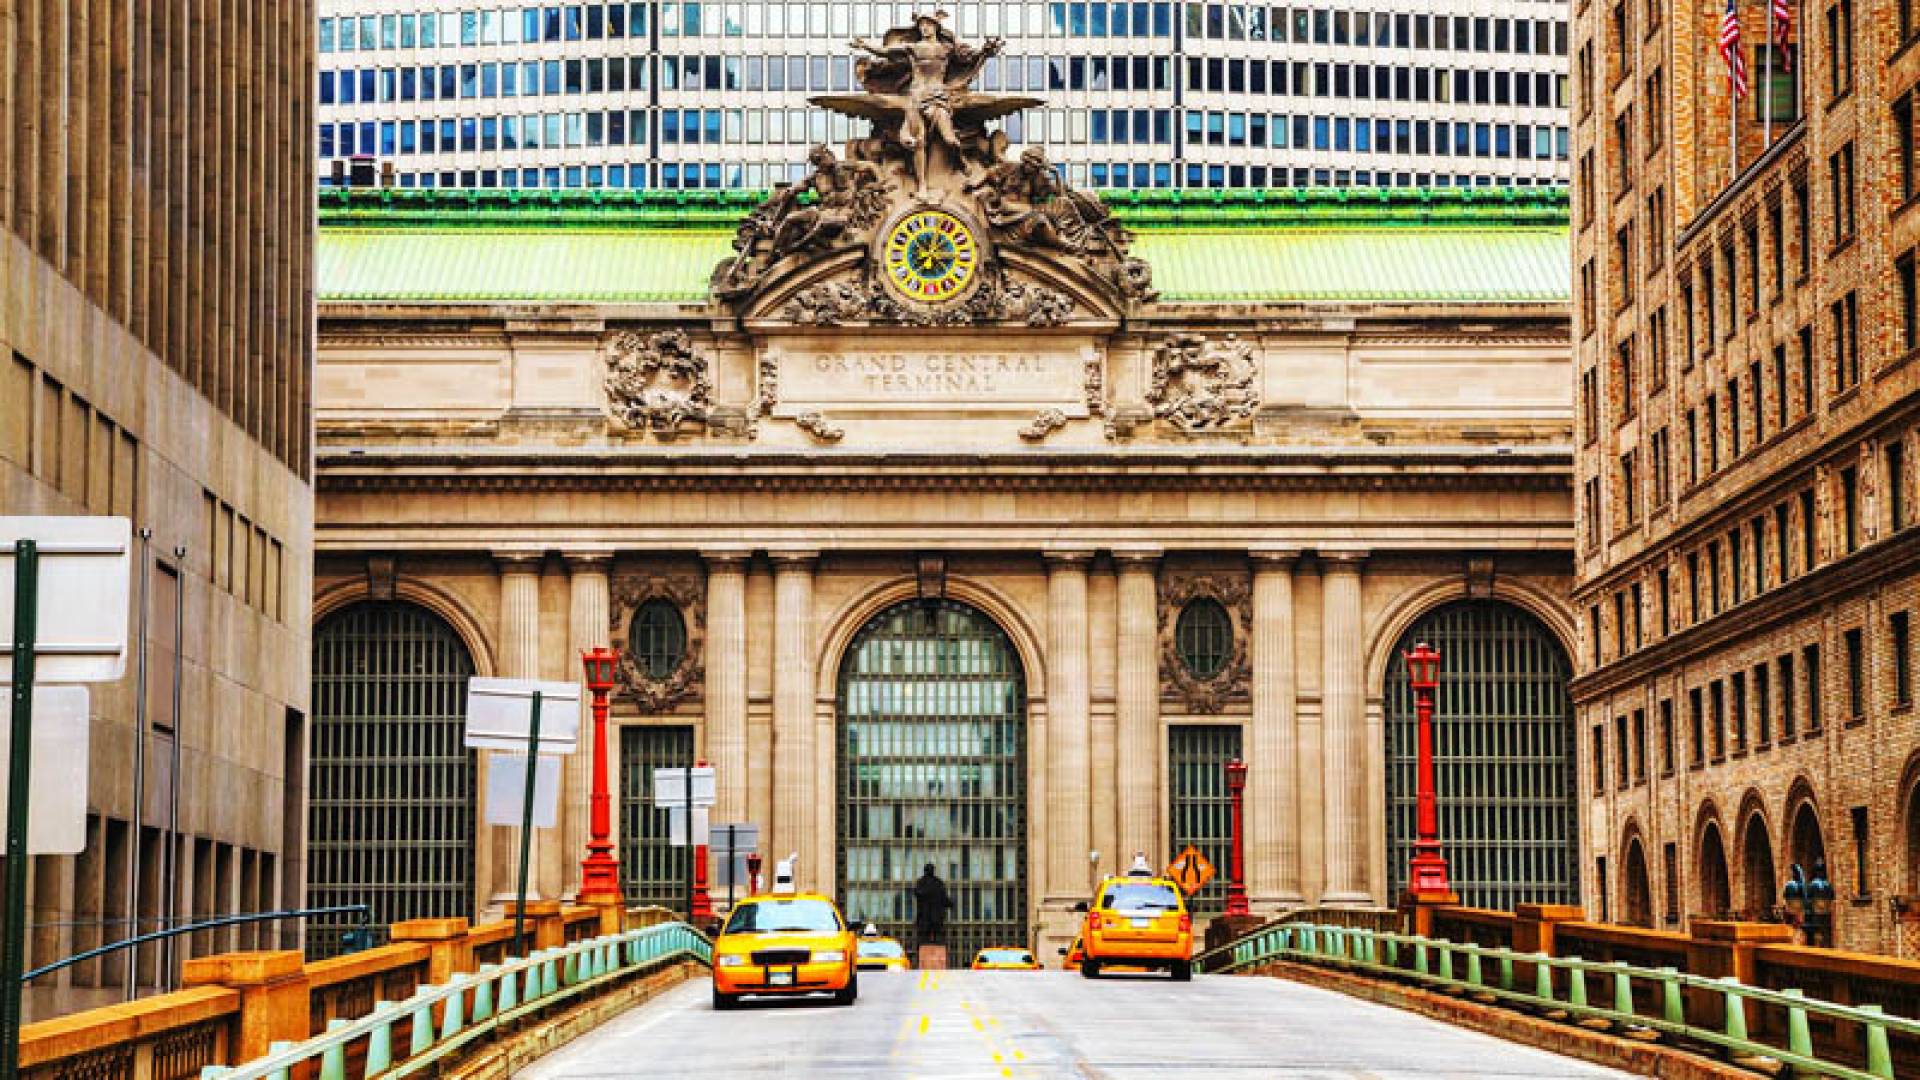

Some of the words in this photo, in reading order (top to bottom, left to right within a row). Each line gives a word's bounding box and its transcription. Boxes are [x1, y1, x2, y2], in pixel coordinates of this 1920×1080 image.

[814, 354, 907, 373] GRAND
[925, 354, 1046, 373] CENTRAL
[864, 374, 997, 393] TERMINAL
